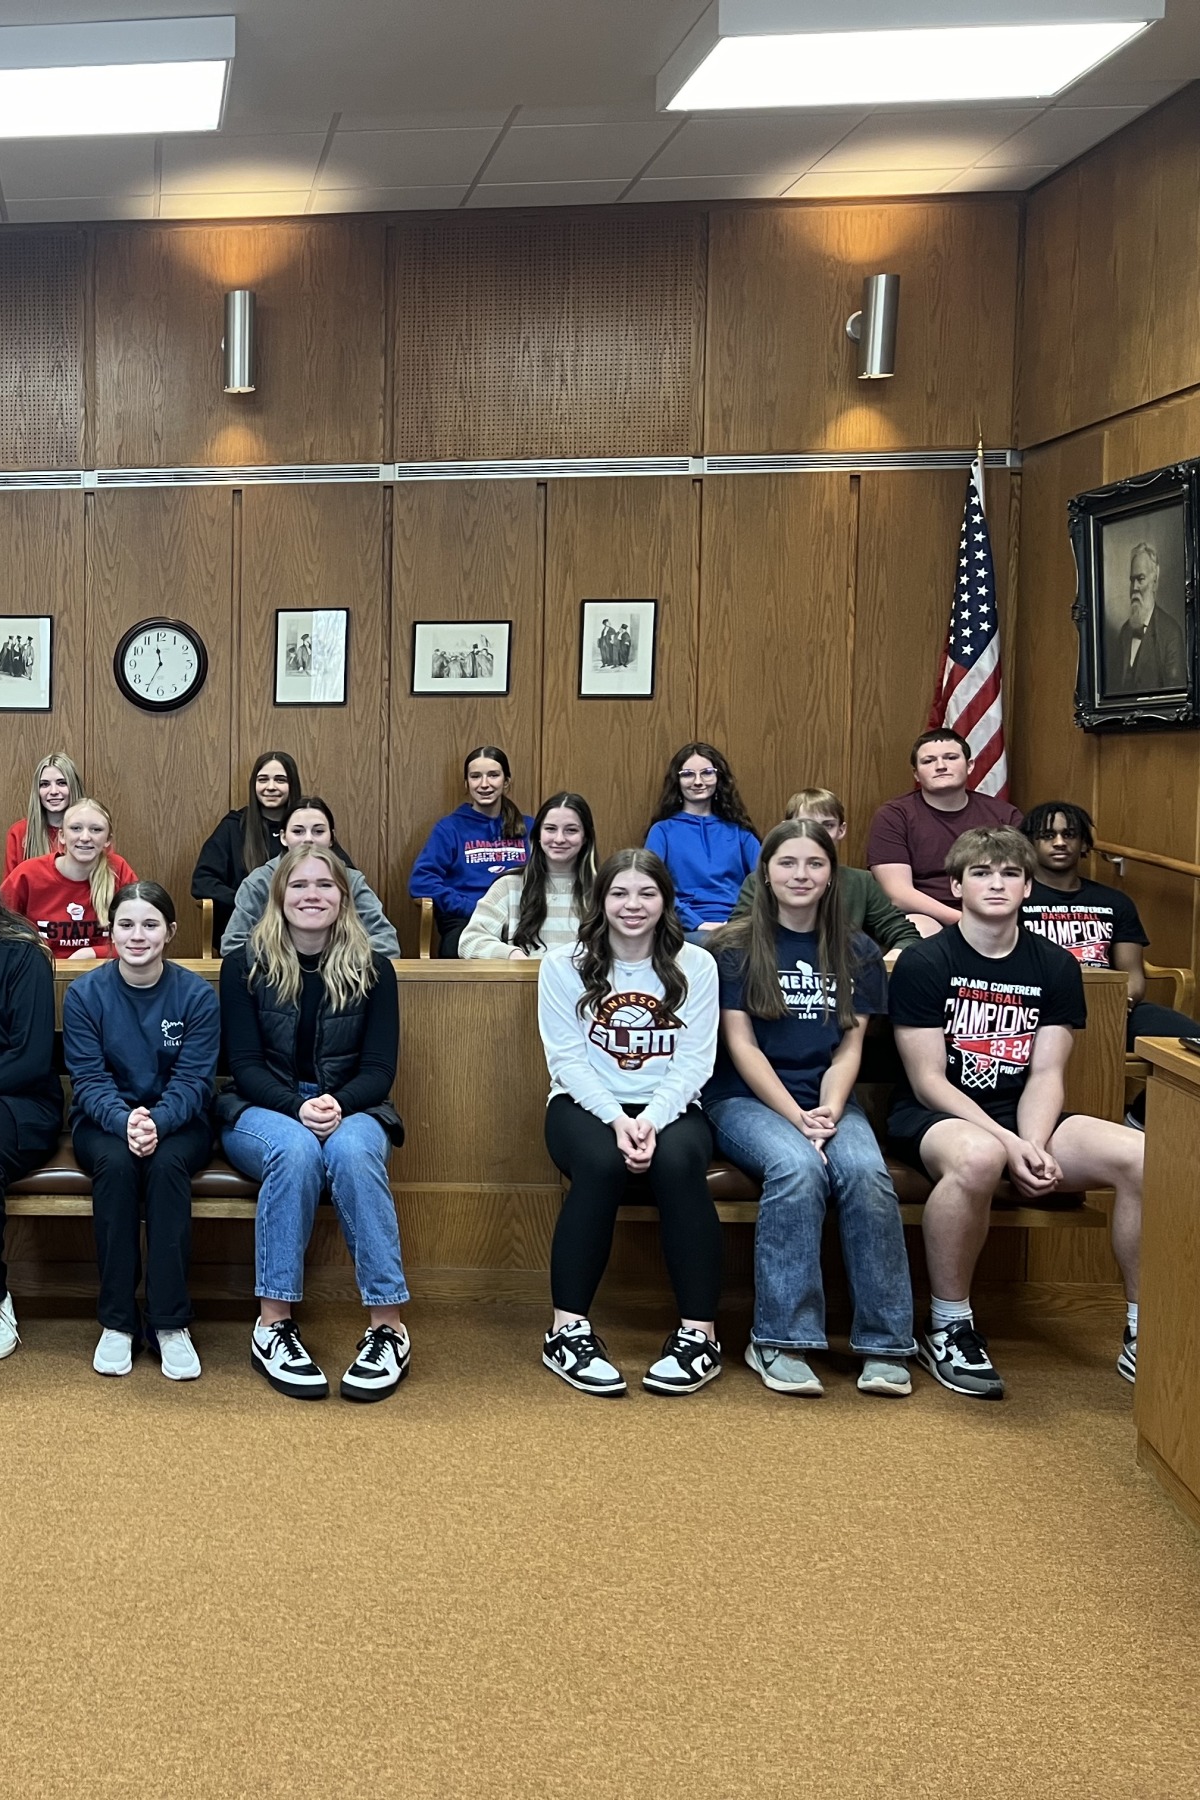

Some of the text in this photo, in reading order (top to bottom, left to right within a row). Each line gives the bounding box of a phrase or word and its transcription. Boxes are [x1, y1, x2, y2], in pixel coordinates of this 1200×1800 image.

[144, 636, 150, 645] 11
[156, 632, 167, 642] 12
[133, 646, 144, 656] 10
[182, 645, 189, 654] 2
[129, 660, 136, 669] 9
[186, 659, 193, 669] 3
[134, 674, 141, 684] 8
[181, 674, 191, 682] 4
[145, 683, 151, 692] 7
[157, 687, 164, 696] 6
[170, 683, 177, 693] 5
[1041, 912, 1100, 920] BASKETBALL
[60, 938, 90, 947] DANCE
[990, 1040, 1031, 1061] 23-24
